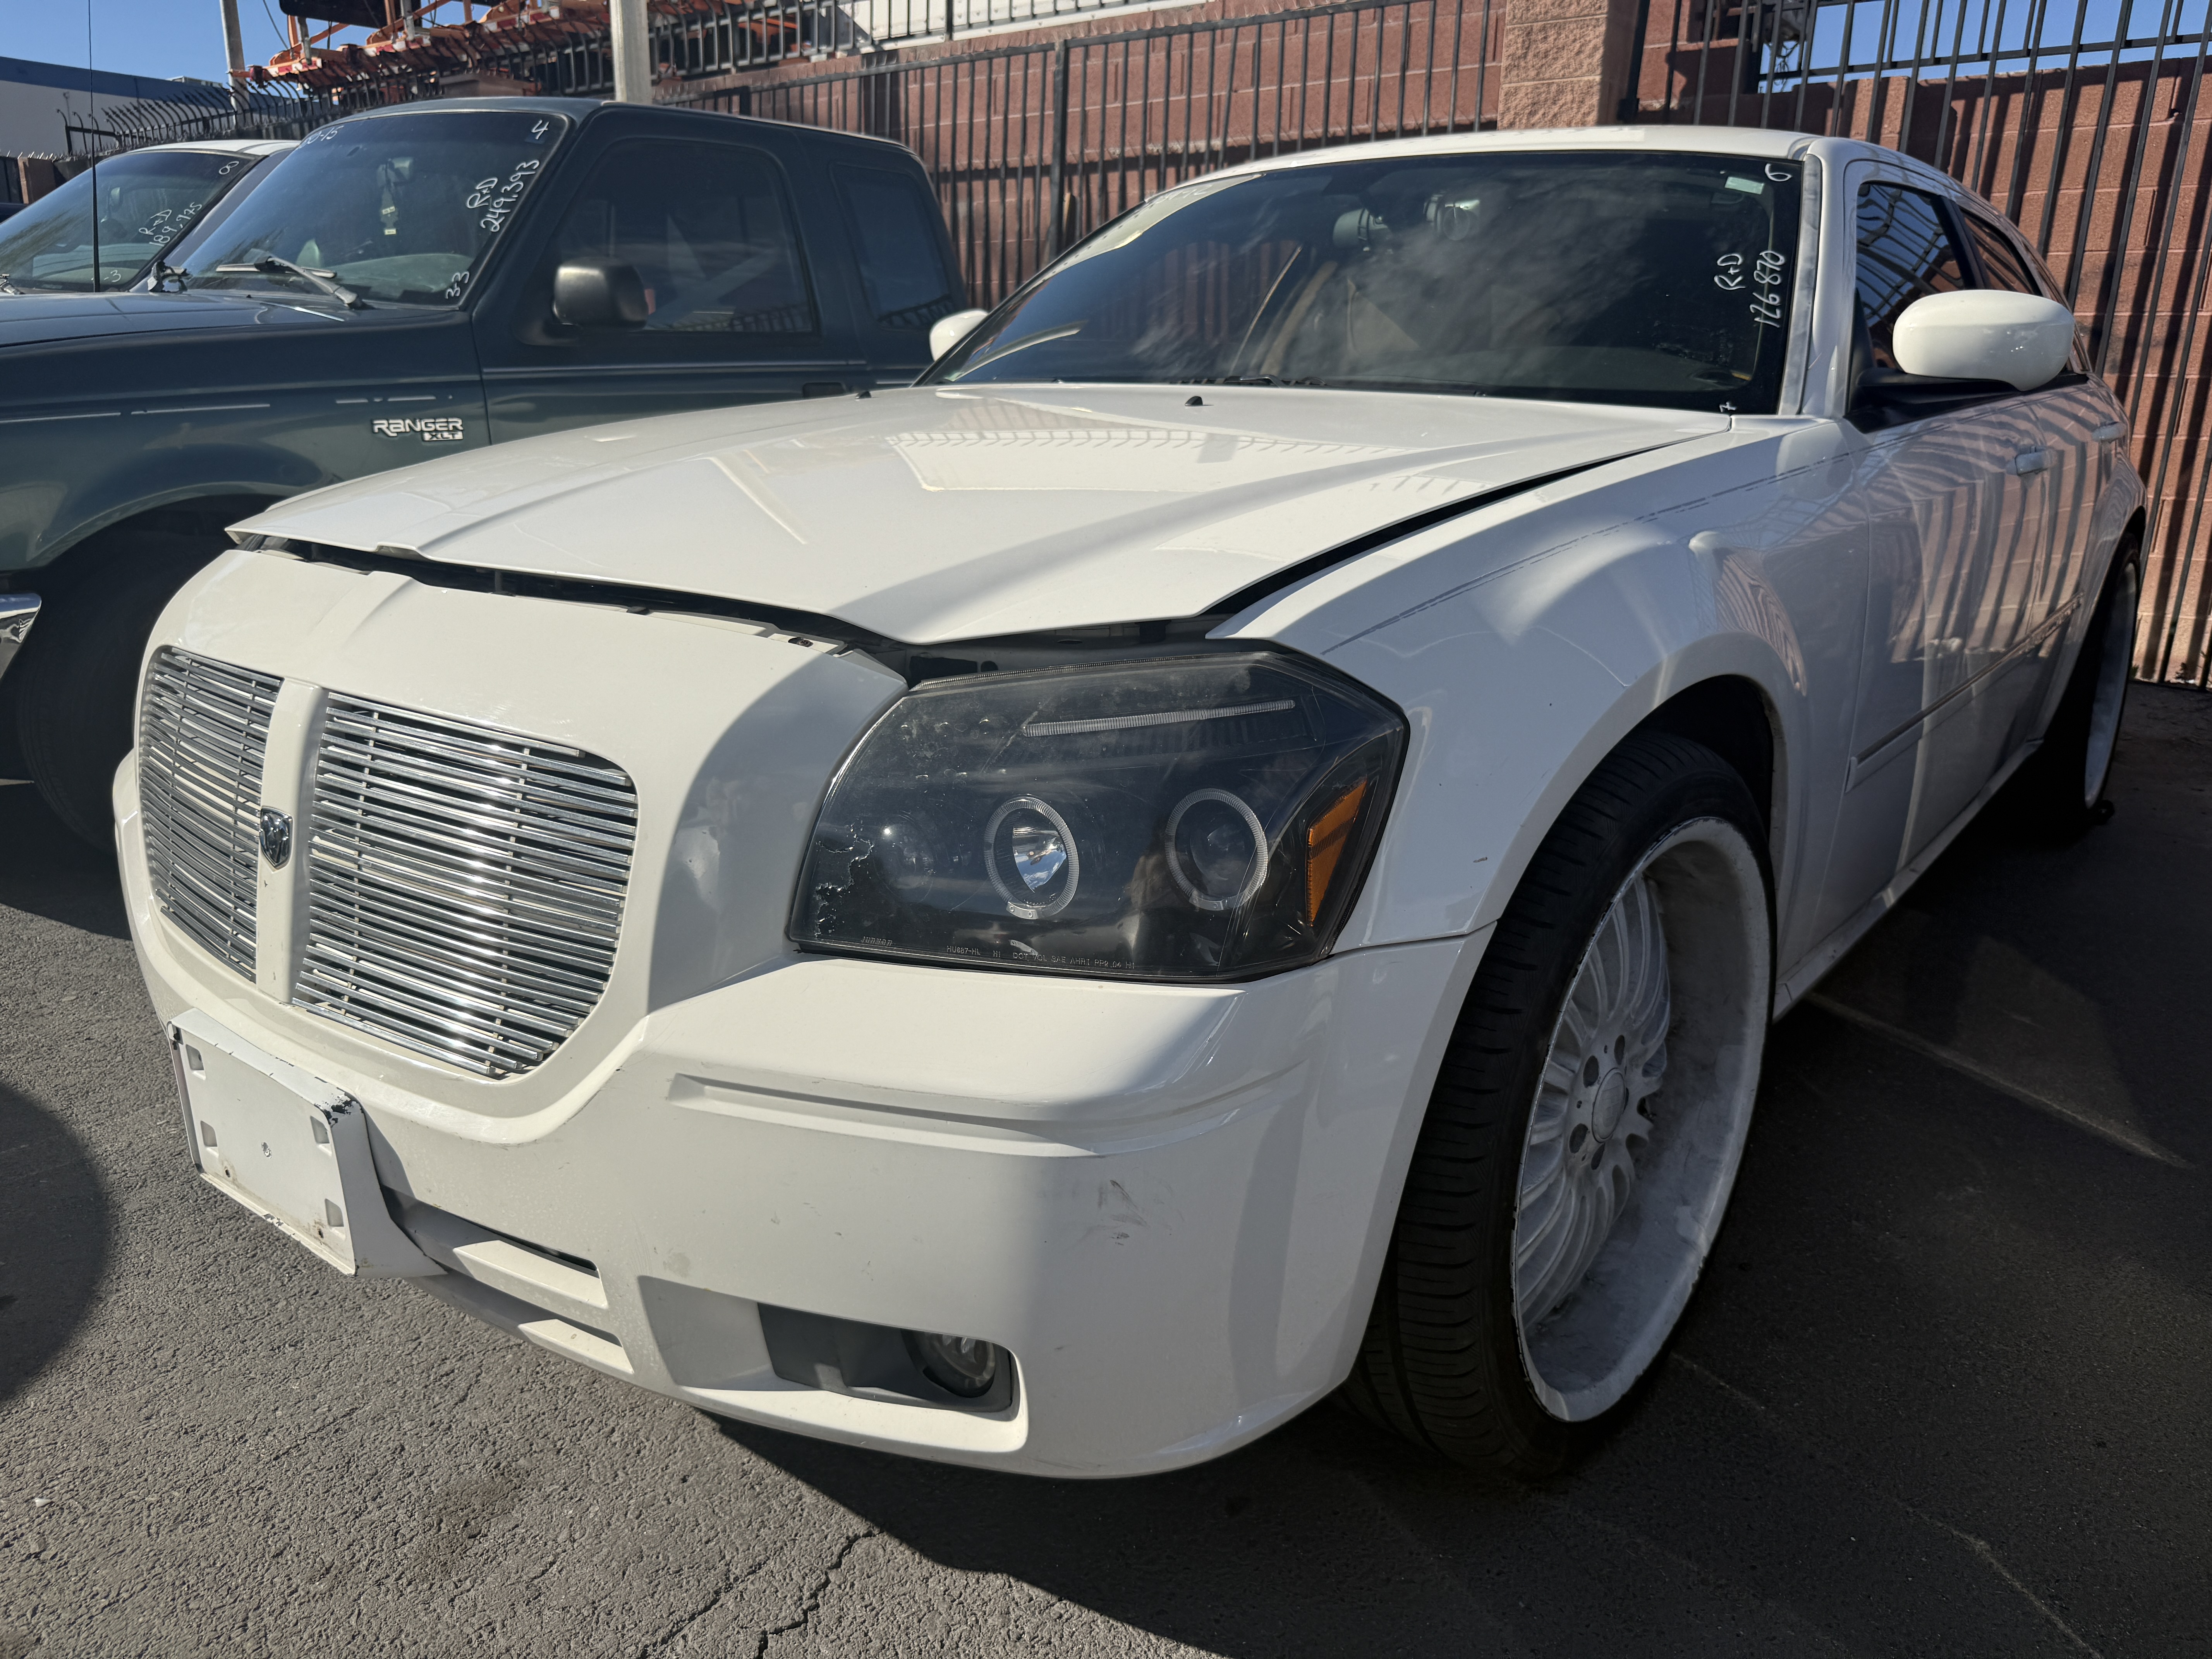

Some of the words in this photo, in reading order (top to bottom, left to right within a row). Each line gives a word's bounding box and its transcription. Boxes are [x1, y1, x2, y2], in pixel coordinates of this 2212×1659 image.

[531, 119, 550, 140] 4
[218, 161, 239, 175] 8
[1013, 952, 1029, 960] DOT
